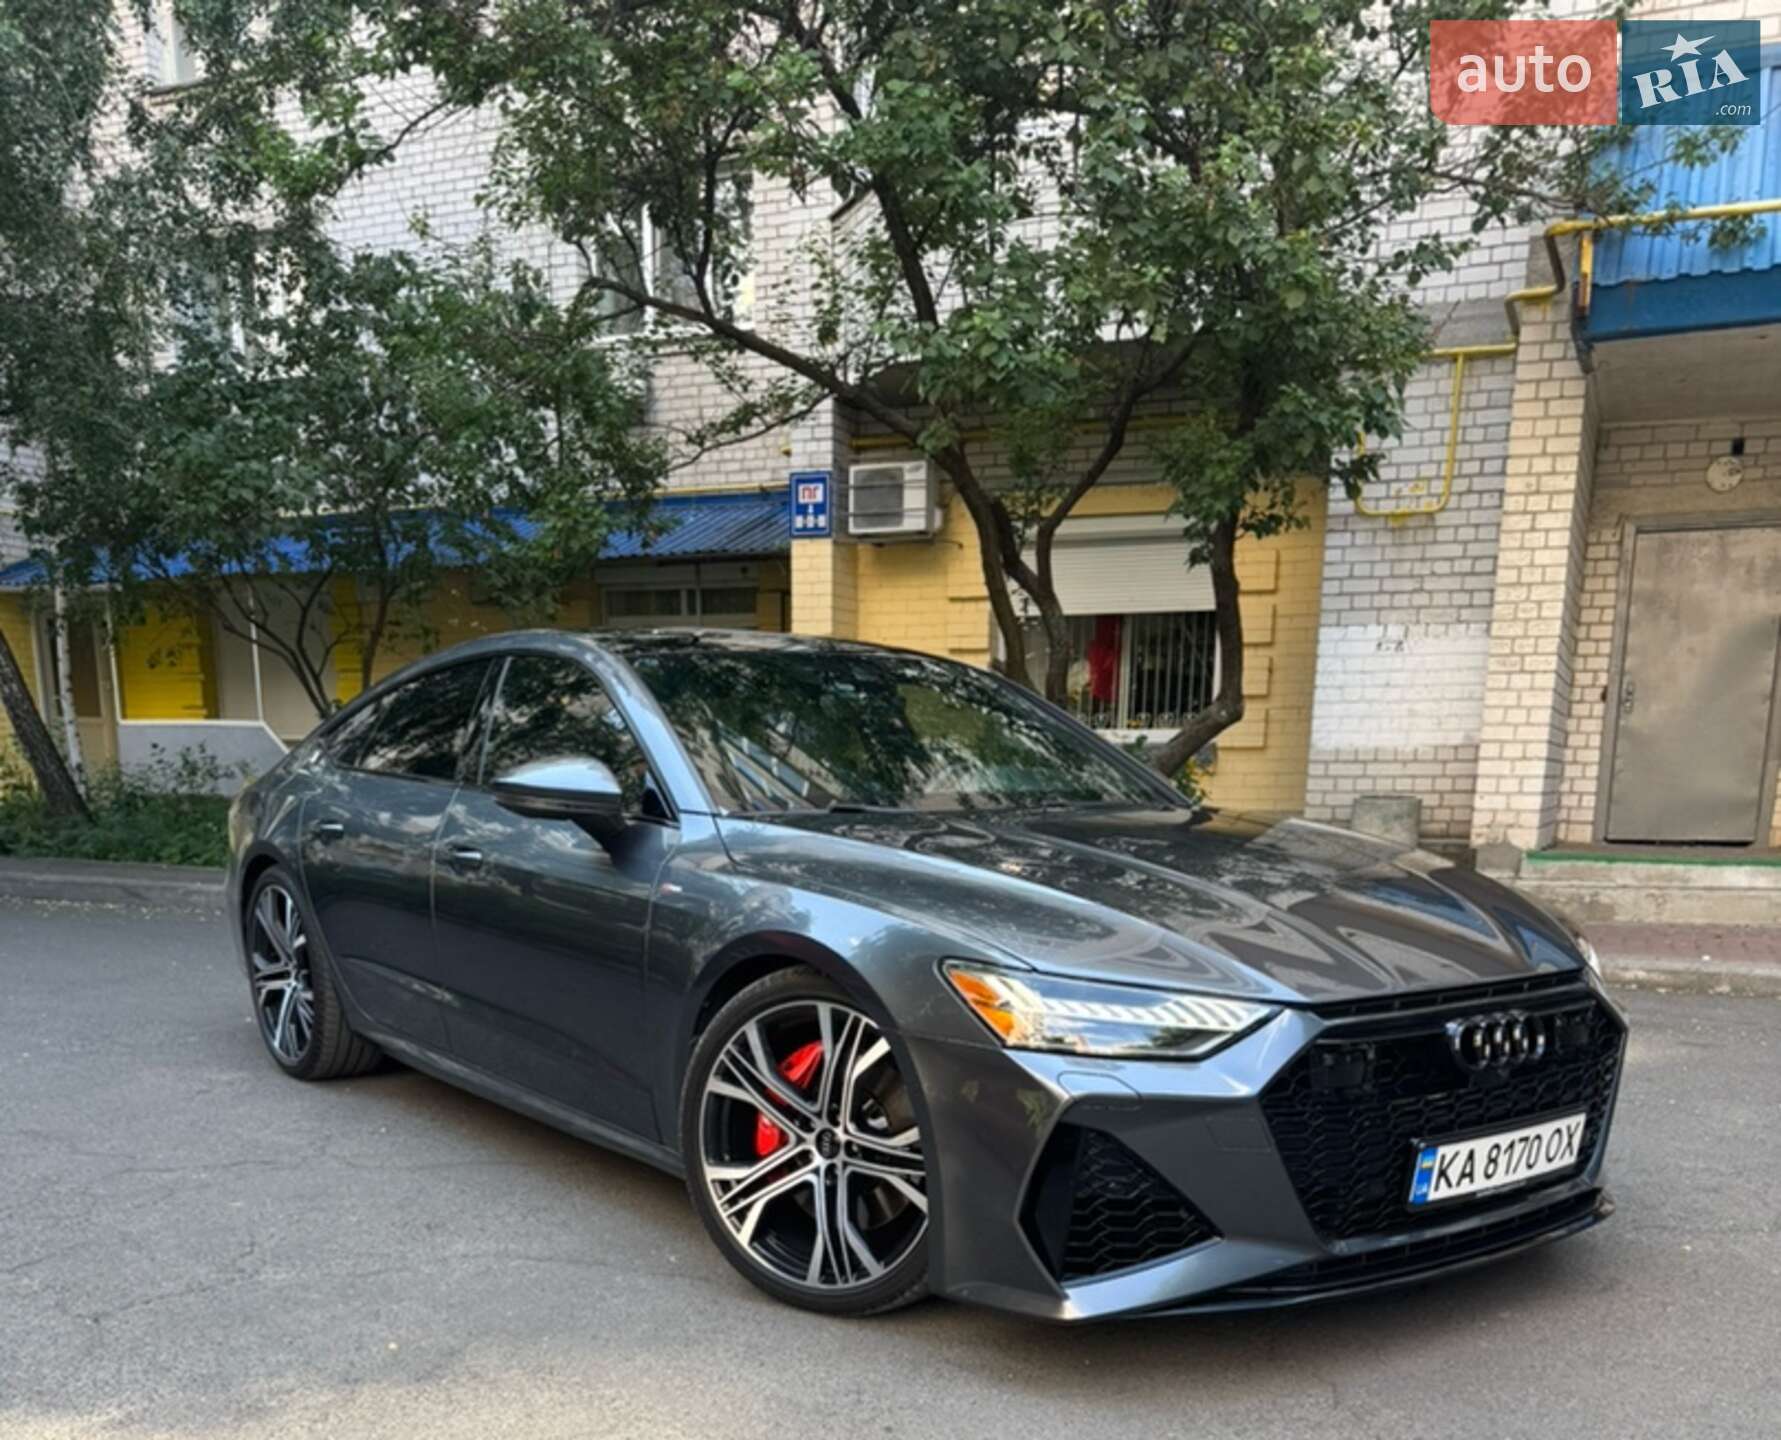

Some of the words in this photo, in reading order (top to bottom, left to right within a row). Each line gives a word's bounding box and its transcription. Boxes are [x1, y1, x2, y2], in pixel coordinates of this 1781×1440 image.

[1434, 1148, 1476, 1192] KA
[1483, 1134, 1543, 1180] 8170
[1545, 1121, 1581, 1163] OX
